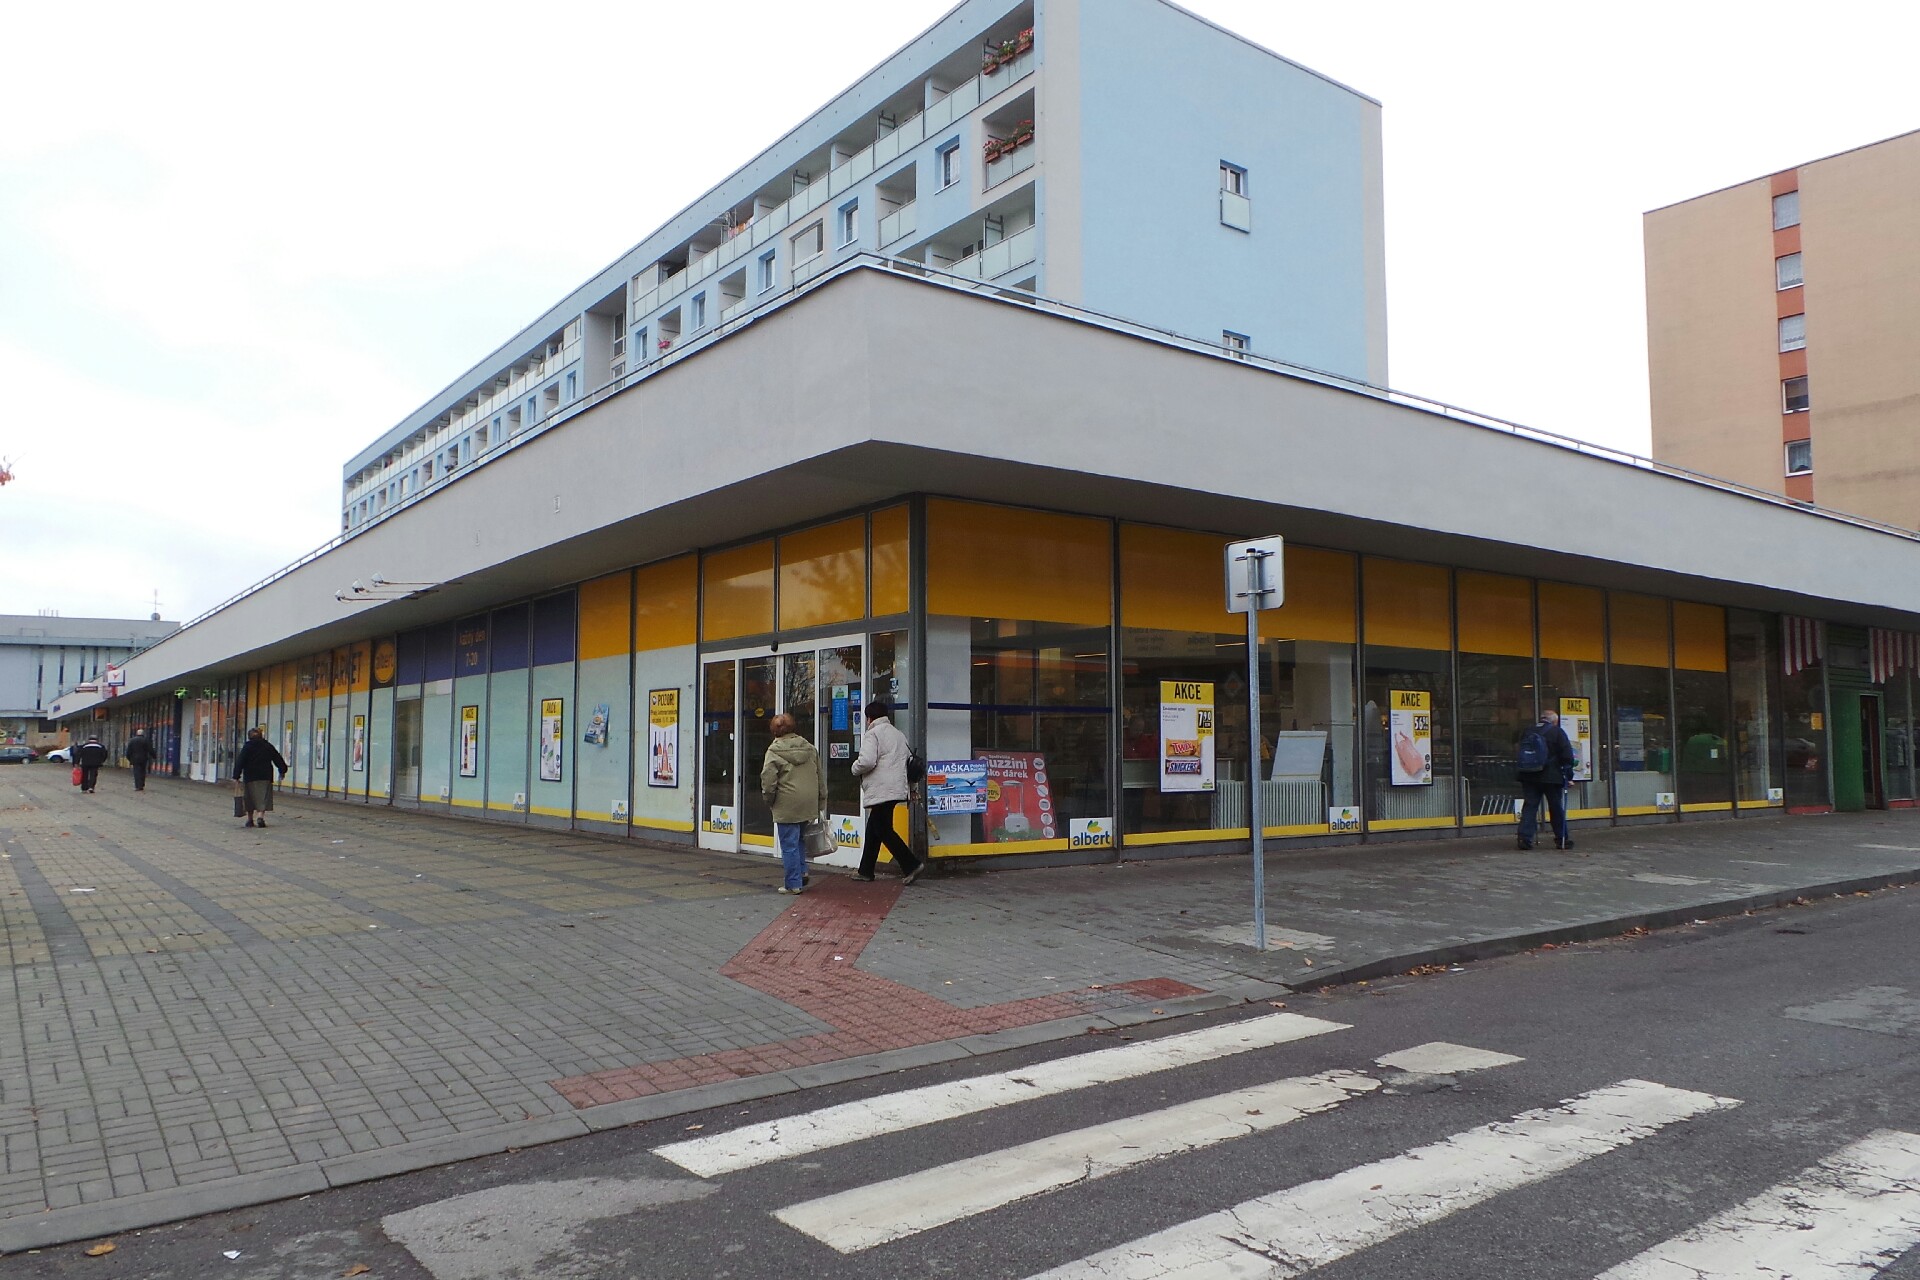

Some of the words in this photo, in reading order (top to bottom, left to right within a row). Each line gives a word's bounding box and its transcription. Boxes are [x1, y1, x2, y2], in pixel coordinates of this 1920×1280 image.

[1174, 683, 1201, 700] AKCE
[1401, 692, 1421, 707] AKCE
[1566, 700, 1583, 712] AKCE
[928, 762, 970, 773] ALJAŠKA
[1002, 769, 1028, 779] dárek
[612, 809, 628, 820] albert
[712, 819, 733, 831] albert
[1331, 818, 1359, 831] albert
[1072, 831, 1111, 847] albert
